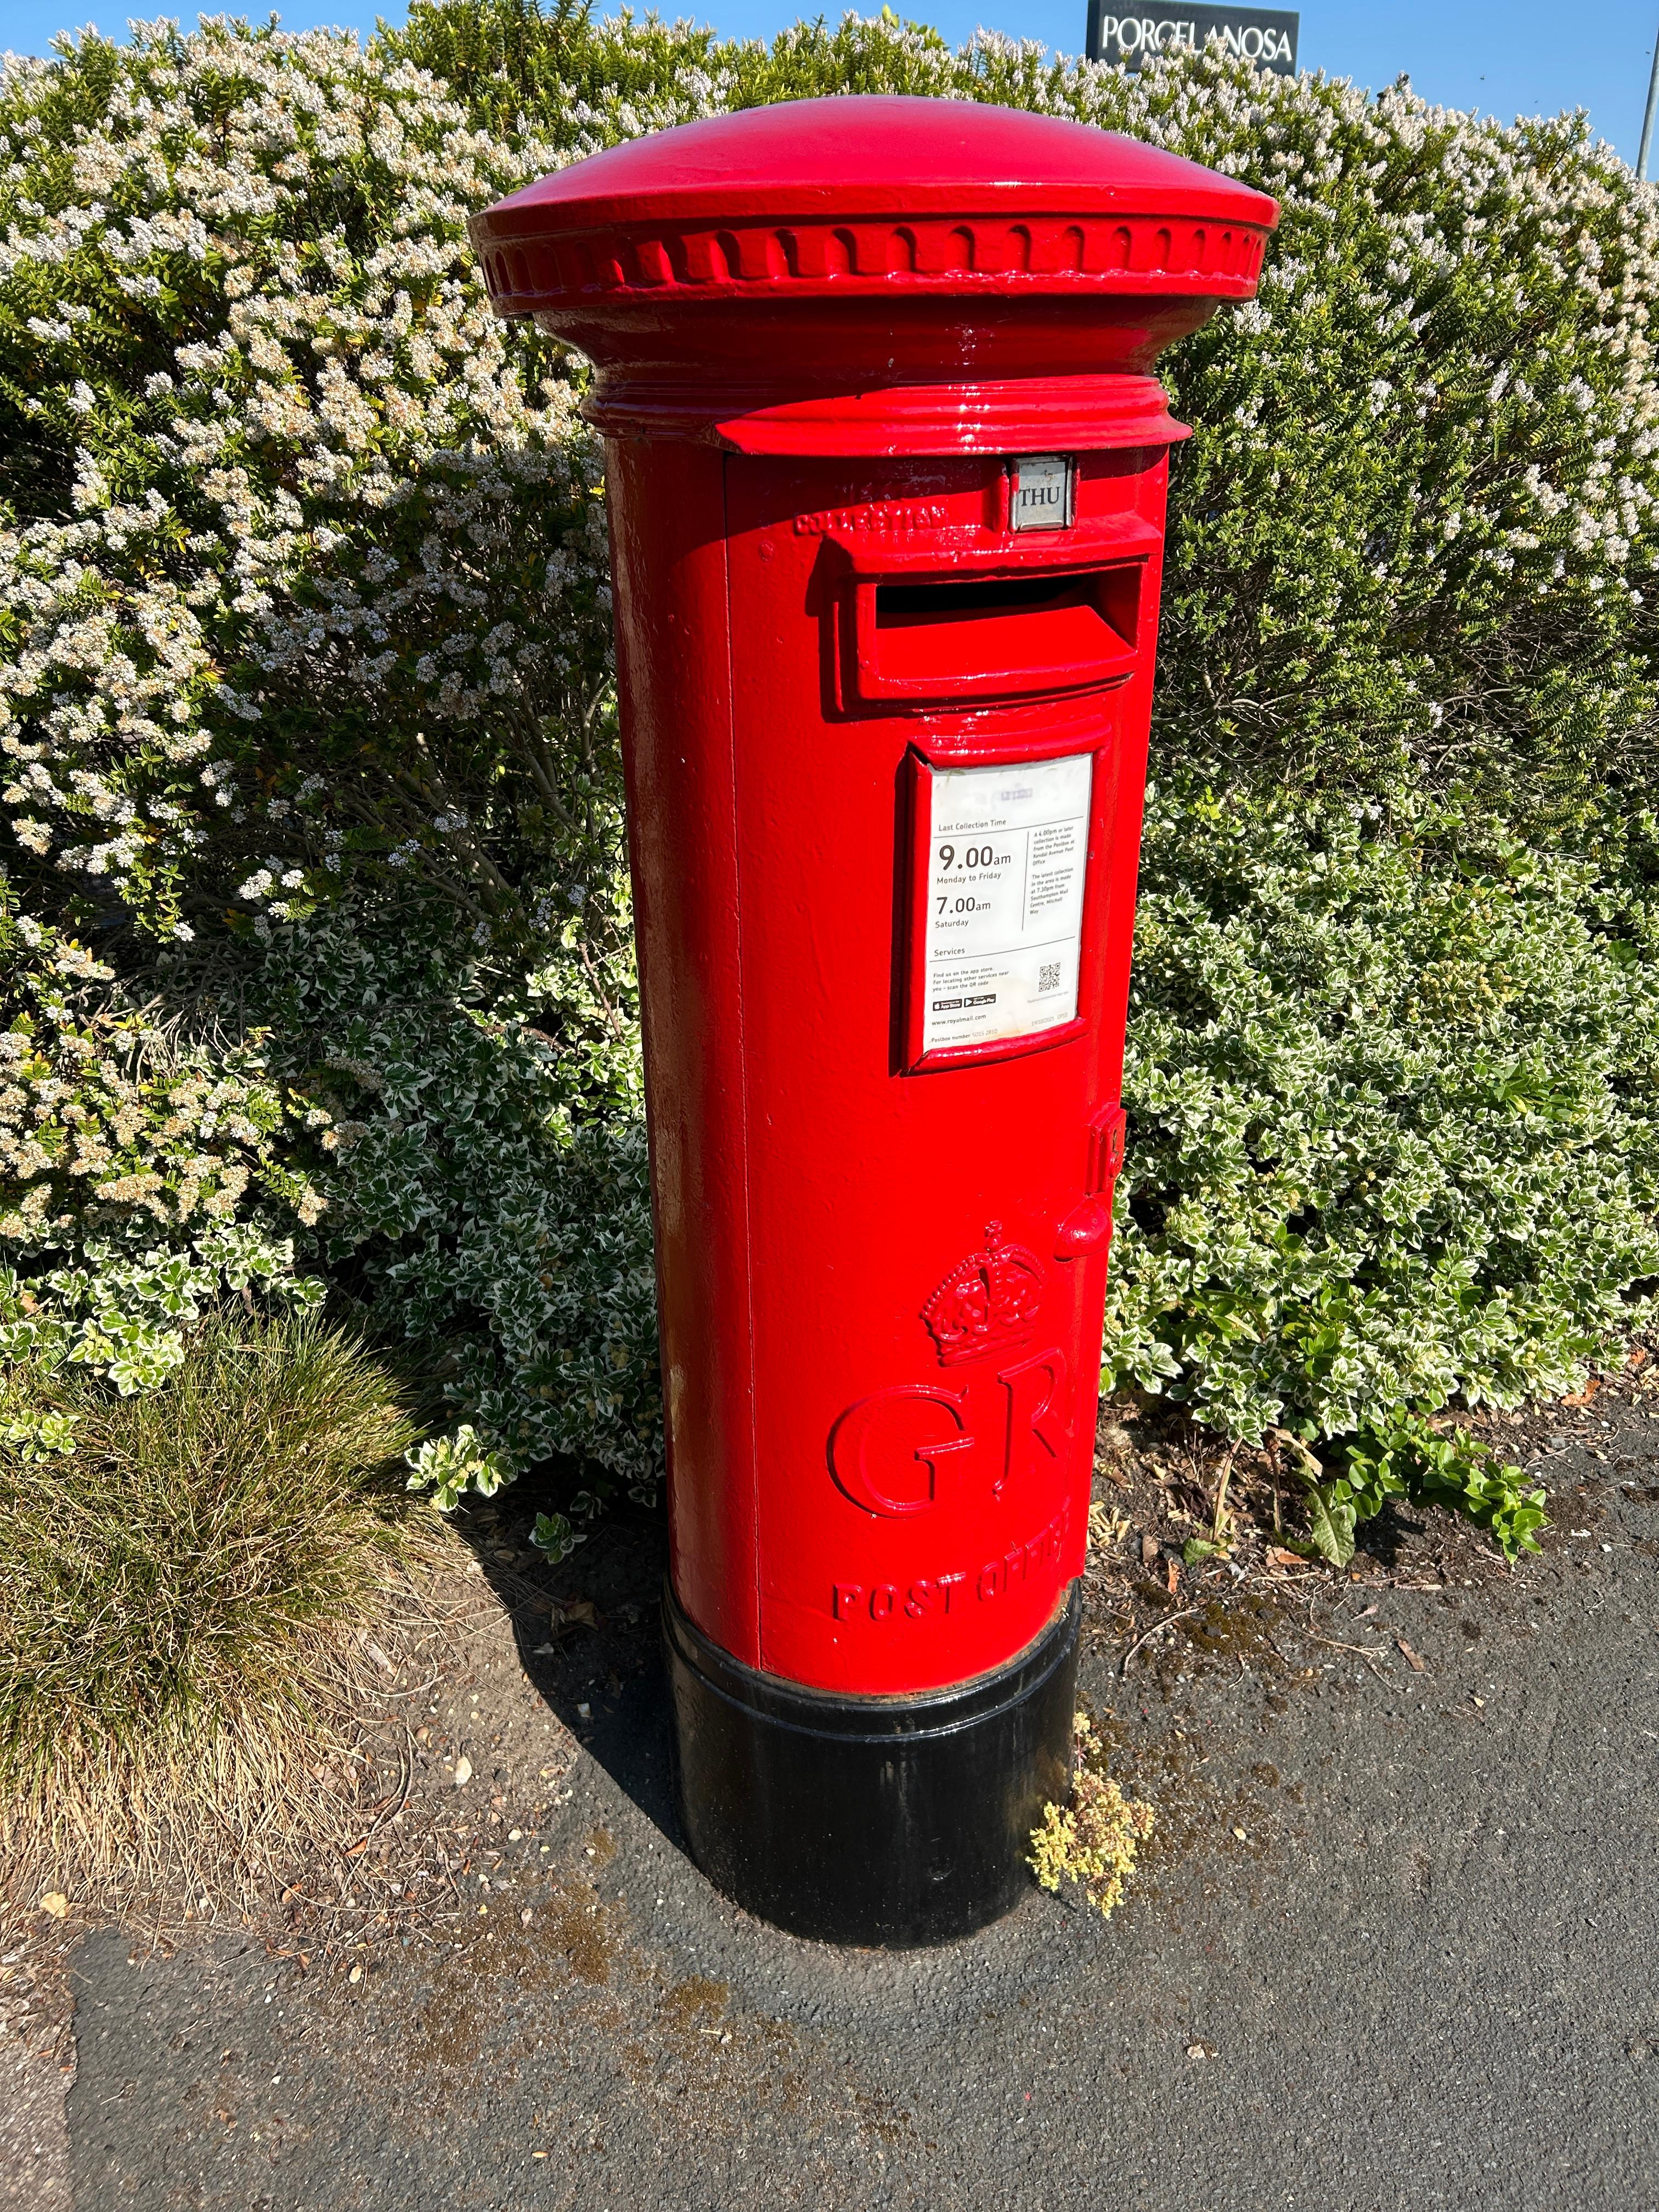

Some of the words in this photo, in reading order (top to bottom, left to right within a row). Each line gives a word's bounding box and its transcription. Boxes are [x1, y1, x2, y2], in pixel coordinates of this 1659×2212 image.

[1102, 15, 1293, 61] PORCELANOSA
[1019, 486, 1060, 506] THU
[956, 821, 989, 830] Collection
[939, 845, 1011, 871] 9.00am
[936, 876, 966, 884] Monday
[979, 872, 1001, 881] Friday
[1030, 892, 1059, 901] Southampton
[936, 896, 991, 915] 7.00am
[935, 919, 969, 928] Saturday
[934, 948, 965, 957] Services
[932, 1014, 986, 1026] www.royalmail.com
[826, 1347, 1073, 1519] GR
[832, 1571, 968, 1621] POST
